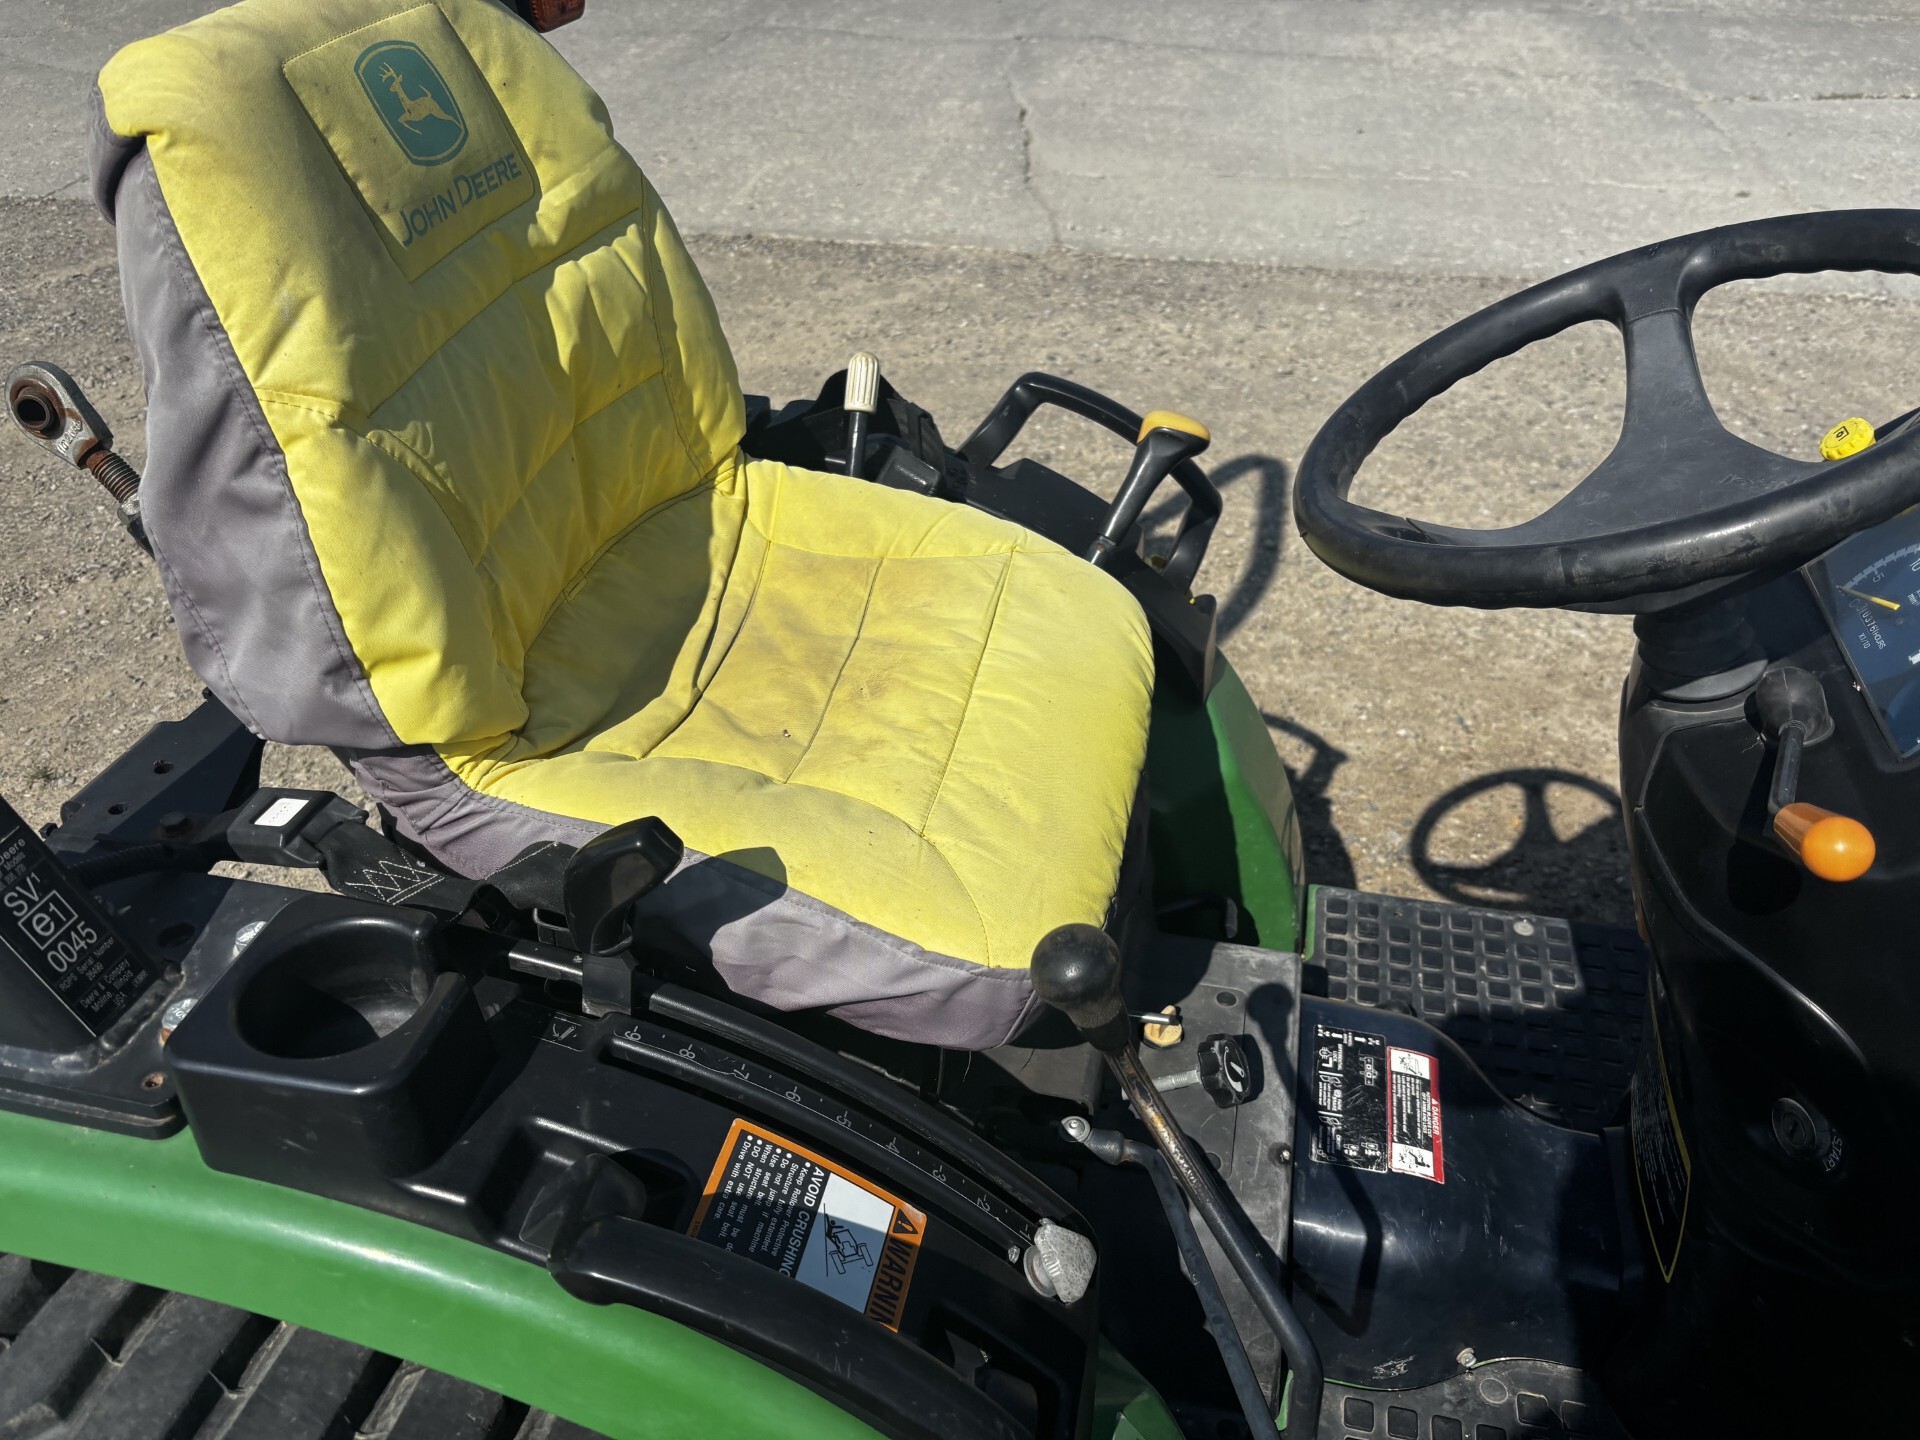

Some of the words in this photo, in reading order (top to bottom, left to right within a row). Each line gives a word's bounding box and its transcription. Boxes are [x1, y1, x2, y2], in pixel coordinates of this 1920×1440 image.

[399, 187, 456, 246] JOHN
[454, 153, 523, 209] DEERE
[1873, 572, 1885, 582] 5
[47, 921, 97, 972] 0045
[76, 955, 95, 975] Serial
[80, 989, 100, 1009] Deere
[104, 958, 131, 984] Company
[737, 1140, 752, 1160] Drive
[750, 1145, 761, 1158] DO
[759, 1144, 773, 1164] When
[1822, 1136, 1842, 1172] START
[730, 1162, 742, 1179] with
[742, 1161, 755, 1179] NOT
[768, 1154, 780, 1168] Use
[780, 1158, 790, 1169] Do
[745, 1167, 763, 1200] structure
[761, 1171, 772, 1188] seat
[773, 1172, 784, 1186] not
[781, 1162, 799, 1195] Structure
[795, 1167, 809, 1186] Keep
[722, 1180, 735, 1199] extra
[735, 1182, 745, 1196] use
[803, 1166, 825, 1207] AVOID
[753, 1191, 766, 1207] belt.
[764, 1188, 778, 1208] jump
[773, 1198, 786, 1216] fully
[785, 1187, 801, 1218] Rollover
[713, 1201, 726, 1220] care.
[726, 1201, 738, 1218] seat
[736, 1204, 749, 1224] must
[718, 1222, 731, 1239] belt.
[730, 1227, 741, 1238] be
[748, 1221, 765, 1253] machine
[760, 1217, 778, 1253] extended.
[770, 1219, 790, 1257] Protective
[724, 1242, 734, 1253] do
[869, 1238, 914, 1325] WARNIN
